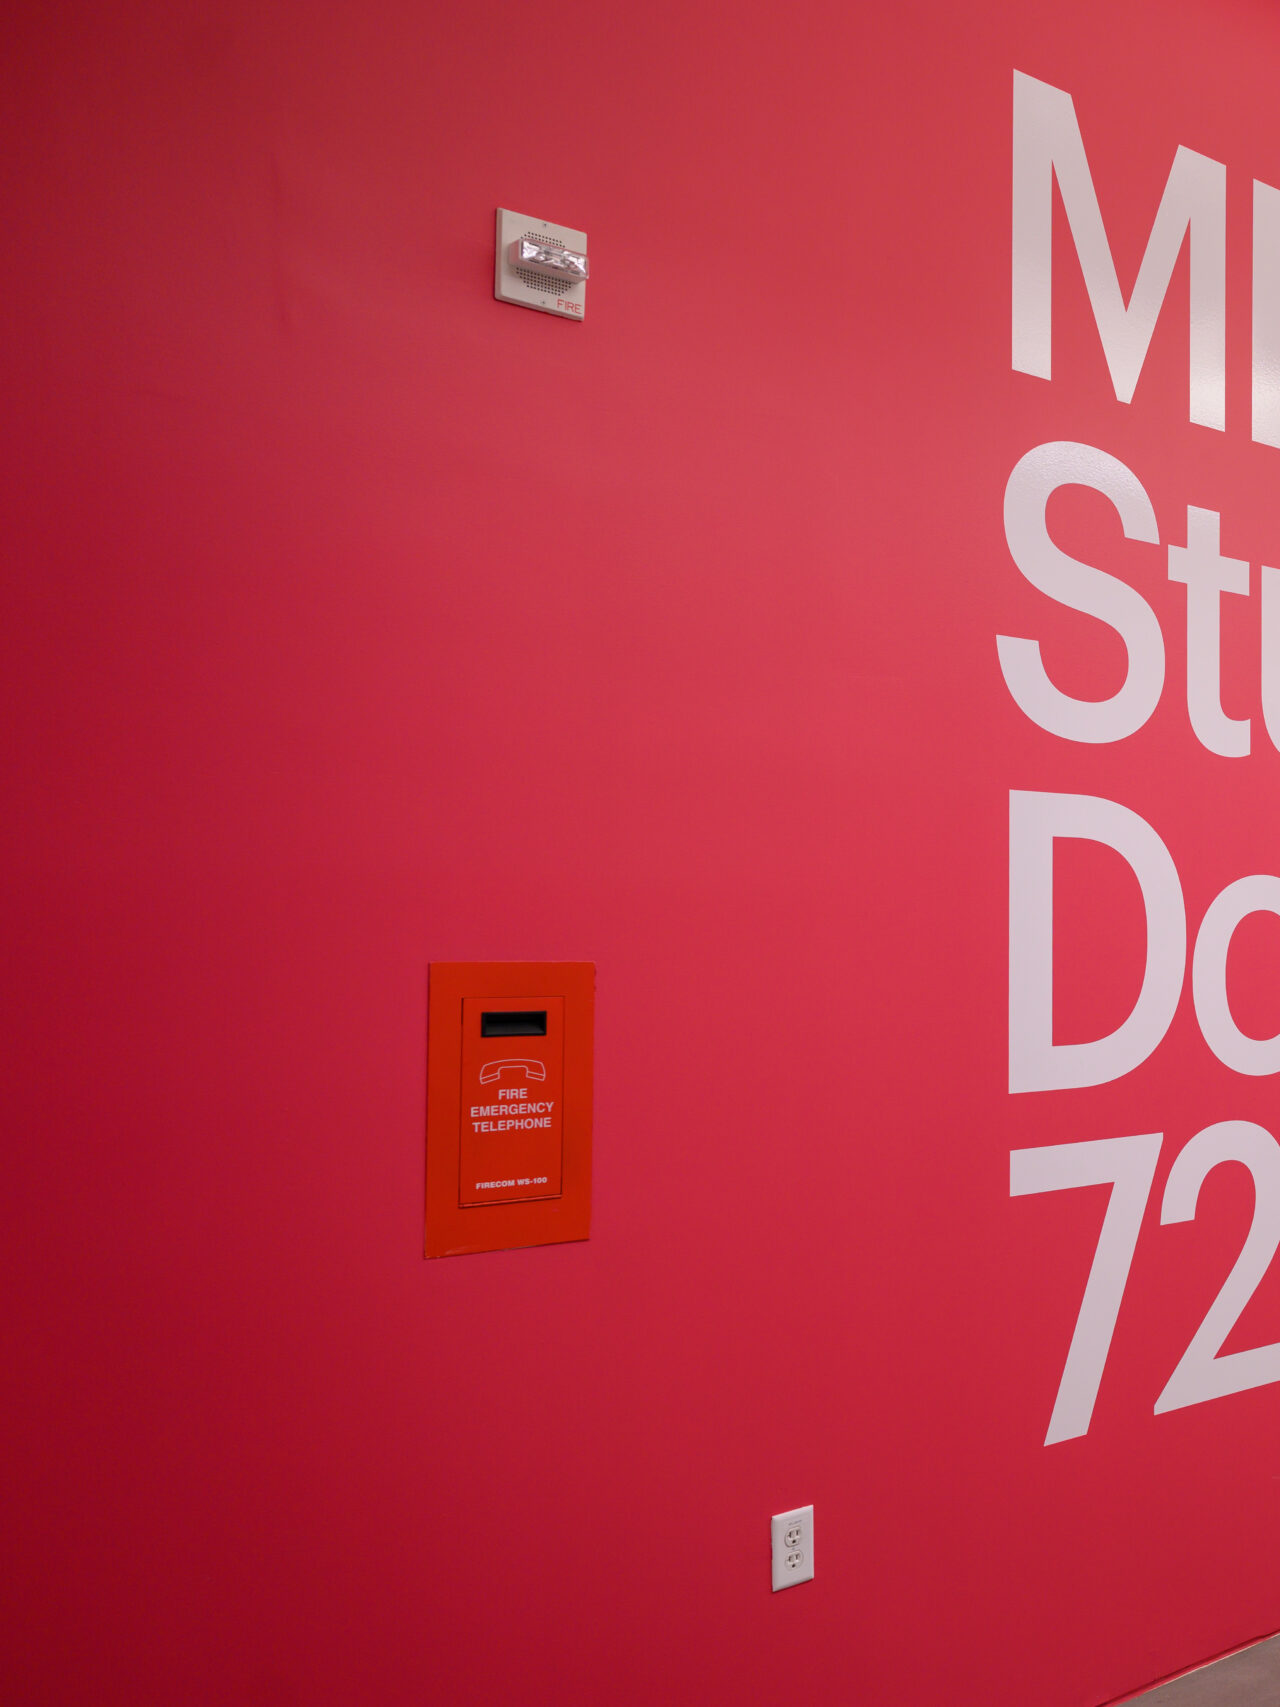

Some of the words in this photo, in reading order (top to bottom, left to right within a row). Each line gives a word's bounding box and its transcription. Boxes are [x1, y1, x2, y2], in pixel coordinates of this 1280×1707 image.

[556, 298, 583, 314] FIRE
[498, 1088, 528, 1100] FIRE
[470, 1101, 554, 1118] EMERGENCY
[472, 1117, 552, 1133] TELEPHONE
[475, 1179, 515, 1190] FIRECOM
[516, 1176, 548, 1186] WS-100
